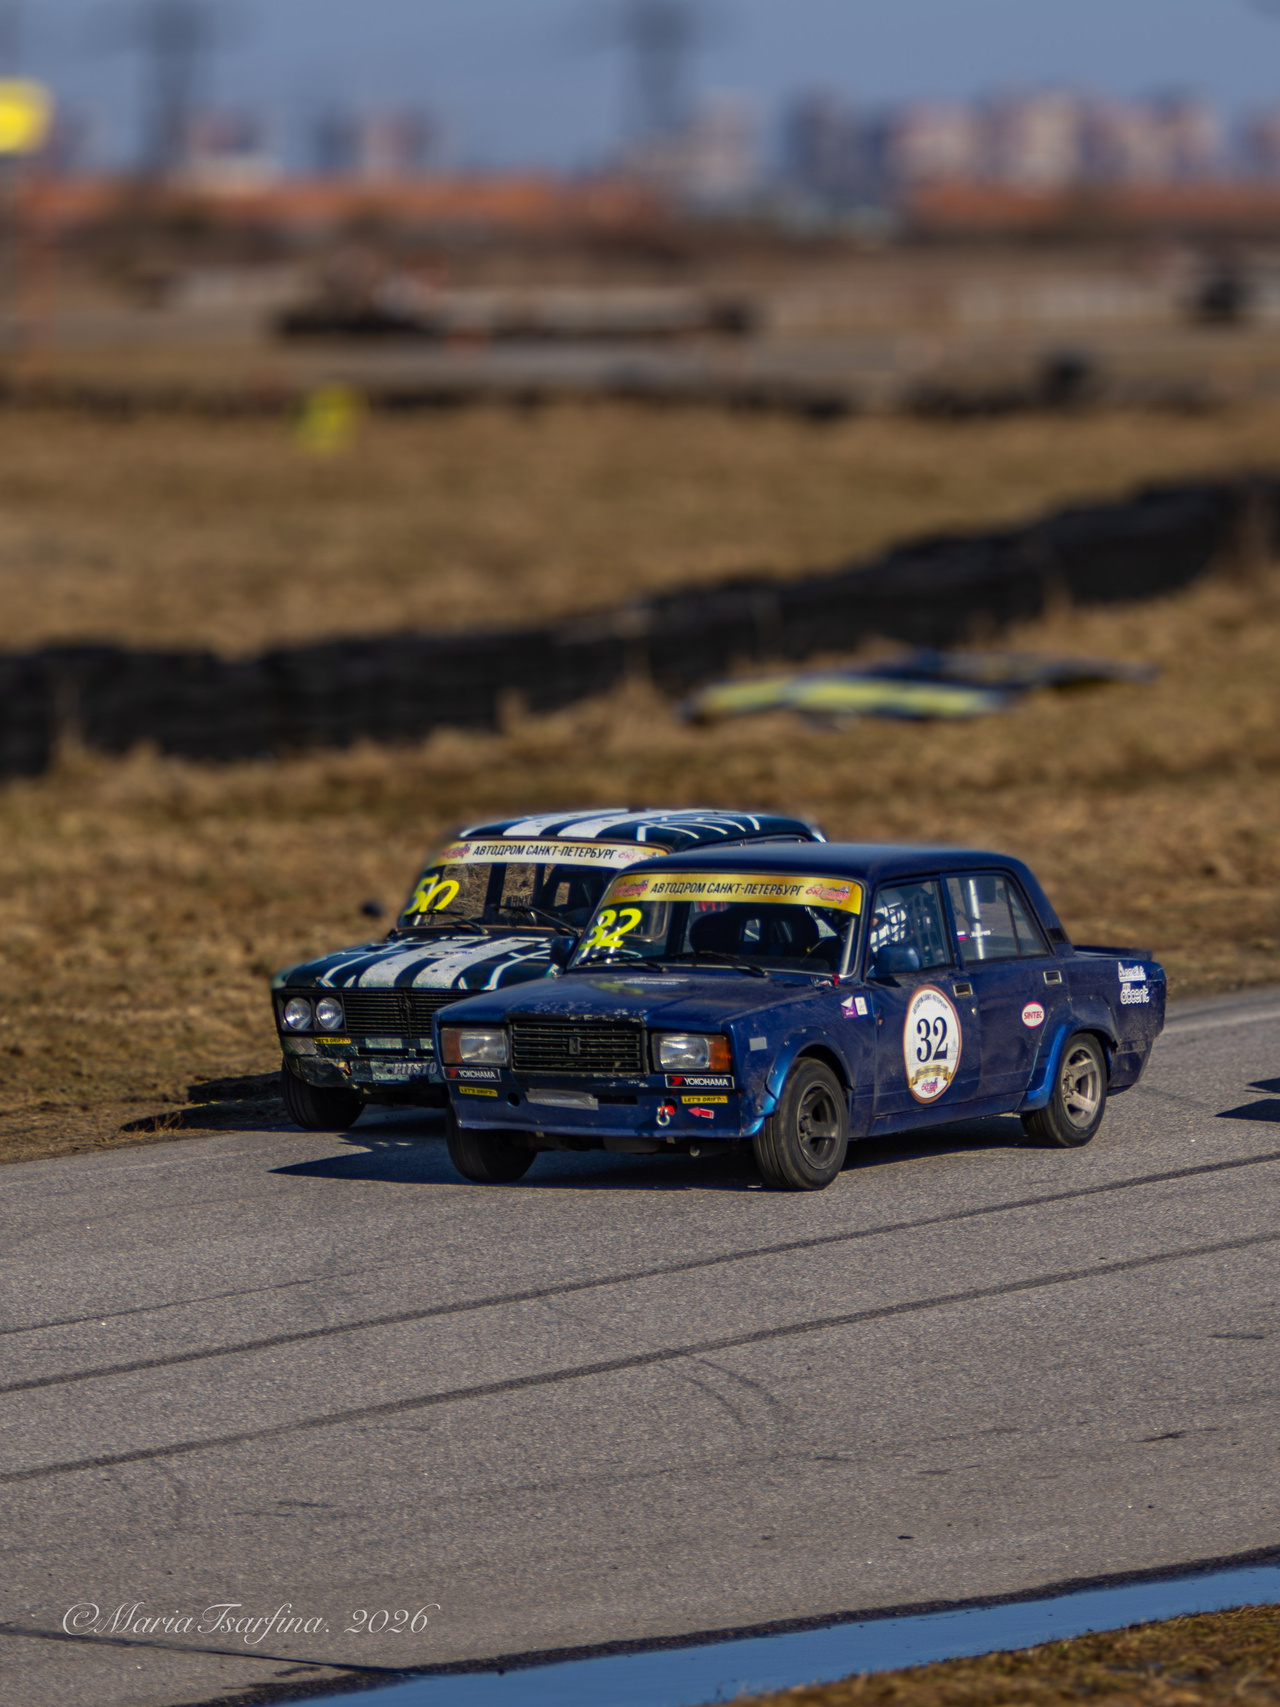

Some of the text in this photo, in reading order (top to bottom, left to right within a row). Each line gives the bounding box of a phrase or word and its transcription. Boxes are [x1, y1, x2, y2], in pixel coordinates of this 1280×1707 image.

[472, 844, 524, 857] АВТОДРОМ
[525, 844, 618, 860] САНКТ-ПЕТЕРБУРГ
[403, 875, 460, 913] 50
[650, 882, 705, 895] АВТОДРОМ
[706, 882, 804, 897] САНКТ-ПЕТЕРБУРГ
[580, 908, 642, 950] 32
[1023, 1010, 1043, 1020] SINTEC
[916, 1016, 949, 1063] 32
[458, 1070, 496, 1079] YOKOHAMA
[683, 1077, 729, 1086] YOKOHAMA
